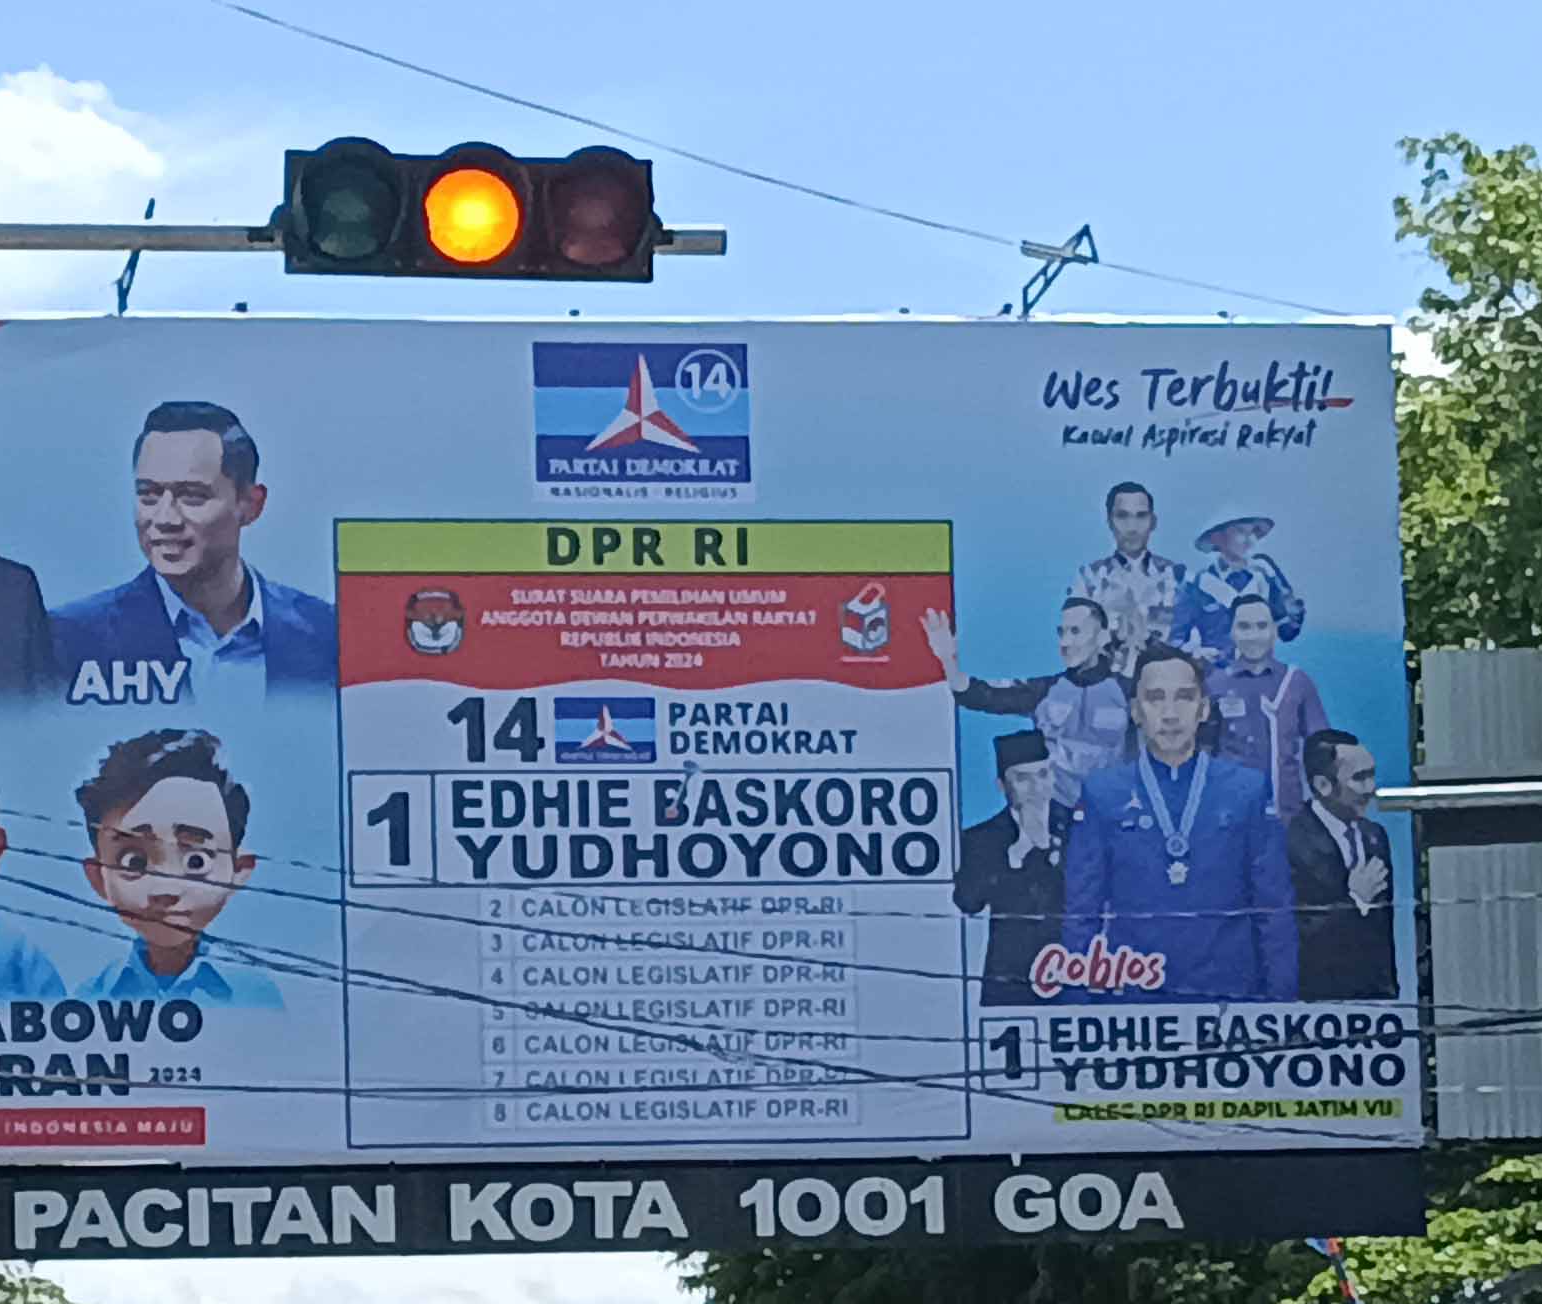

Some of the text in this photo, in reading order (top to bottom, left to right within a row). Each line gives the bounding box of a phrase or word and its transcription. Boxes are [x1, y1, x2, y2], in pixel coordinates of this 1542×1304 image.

[680, 361, 734, 401] 14
[1043, 369, 1120, 410] Wes
[1061, 418, 1319, 457] Kawal Aspirasi Rakyat
[548, 458, 740, 476] PARTAI DEMOKRAT
[546, 526, 750, 567] DPR RI
[510, 588, 788, 606] SURAT SUARA PEMILIHAN UMUM
[481, 609, 817, 627] ANGGOTA DEWAN PERWAKILAN RAKYAT
[560, 631, 742, 647] REPUBLIK INDONESIA
[599, 652, 704, 669] TAHUN 2024
[67, 657, 192, 705] AHY
[668, 702, 790, 727] PARTAI
[446, 696, 546, 764] 14
[668, 729, 859, 755] DEMOKRAT
[451, 776, 940, 829] EDHIE BASKORO
[365, 790, 412, 868] 1
[456, 831, 941, 880] YUDHOYONO
[490, 899, 503, 917] 2
[521, 897, 606, 918] CALON
[614, 896, 753, 917] LEGISLATIF
[491, 933, 503, 952] 3
[522, 931, 608, 952] CALON
[761, 930, 845, 950] DPR-RI
[490, 964, 845, 986] 4 CALON LEGISLATIF DPR-RI
[1032, 937, 1165, 996] Coblos
[617, 998, 755, 1019] LEGISLATIF
[763, 998, 846, 1018] DPR-RI
[524, 1034, 609, 1055] CALON
[1049, 1013, 1405, 1053] EDHIE BASKORO
[988, 1025, 1022, 1080] 1
[147, 1067, 203, 1084] 2024
[493, 1070, 505, 1089] 7
[525, 1070, 610, 1088] CALON
[1052, 1053, 1406, 1092] YUDHOYONO
[493, 1098, 849, 1122] 8 CALON LEGISLATIF DPR-RI
[1141, 1102, 1188, 1120] DPR
[1221, 1101, 1288, 1119] DAPIL
[1293, 1100, 1358, 1118] JATIM
[3, 1120, 129, 1135] INDONESIA
[136, 1120, 195, 1135] MAJU
[12, 1171, 1184, 1251] PACITAN KOTA 1001 GOA
